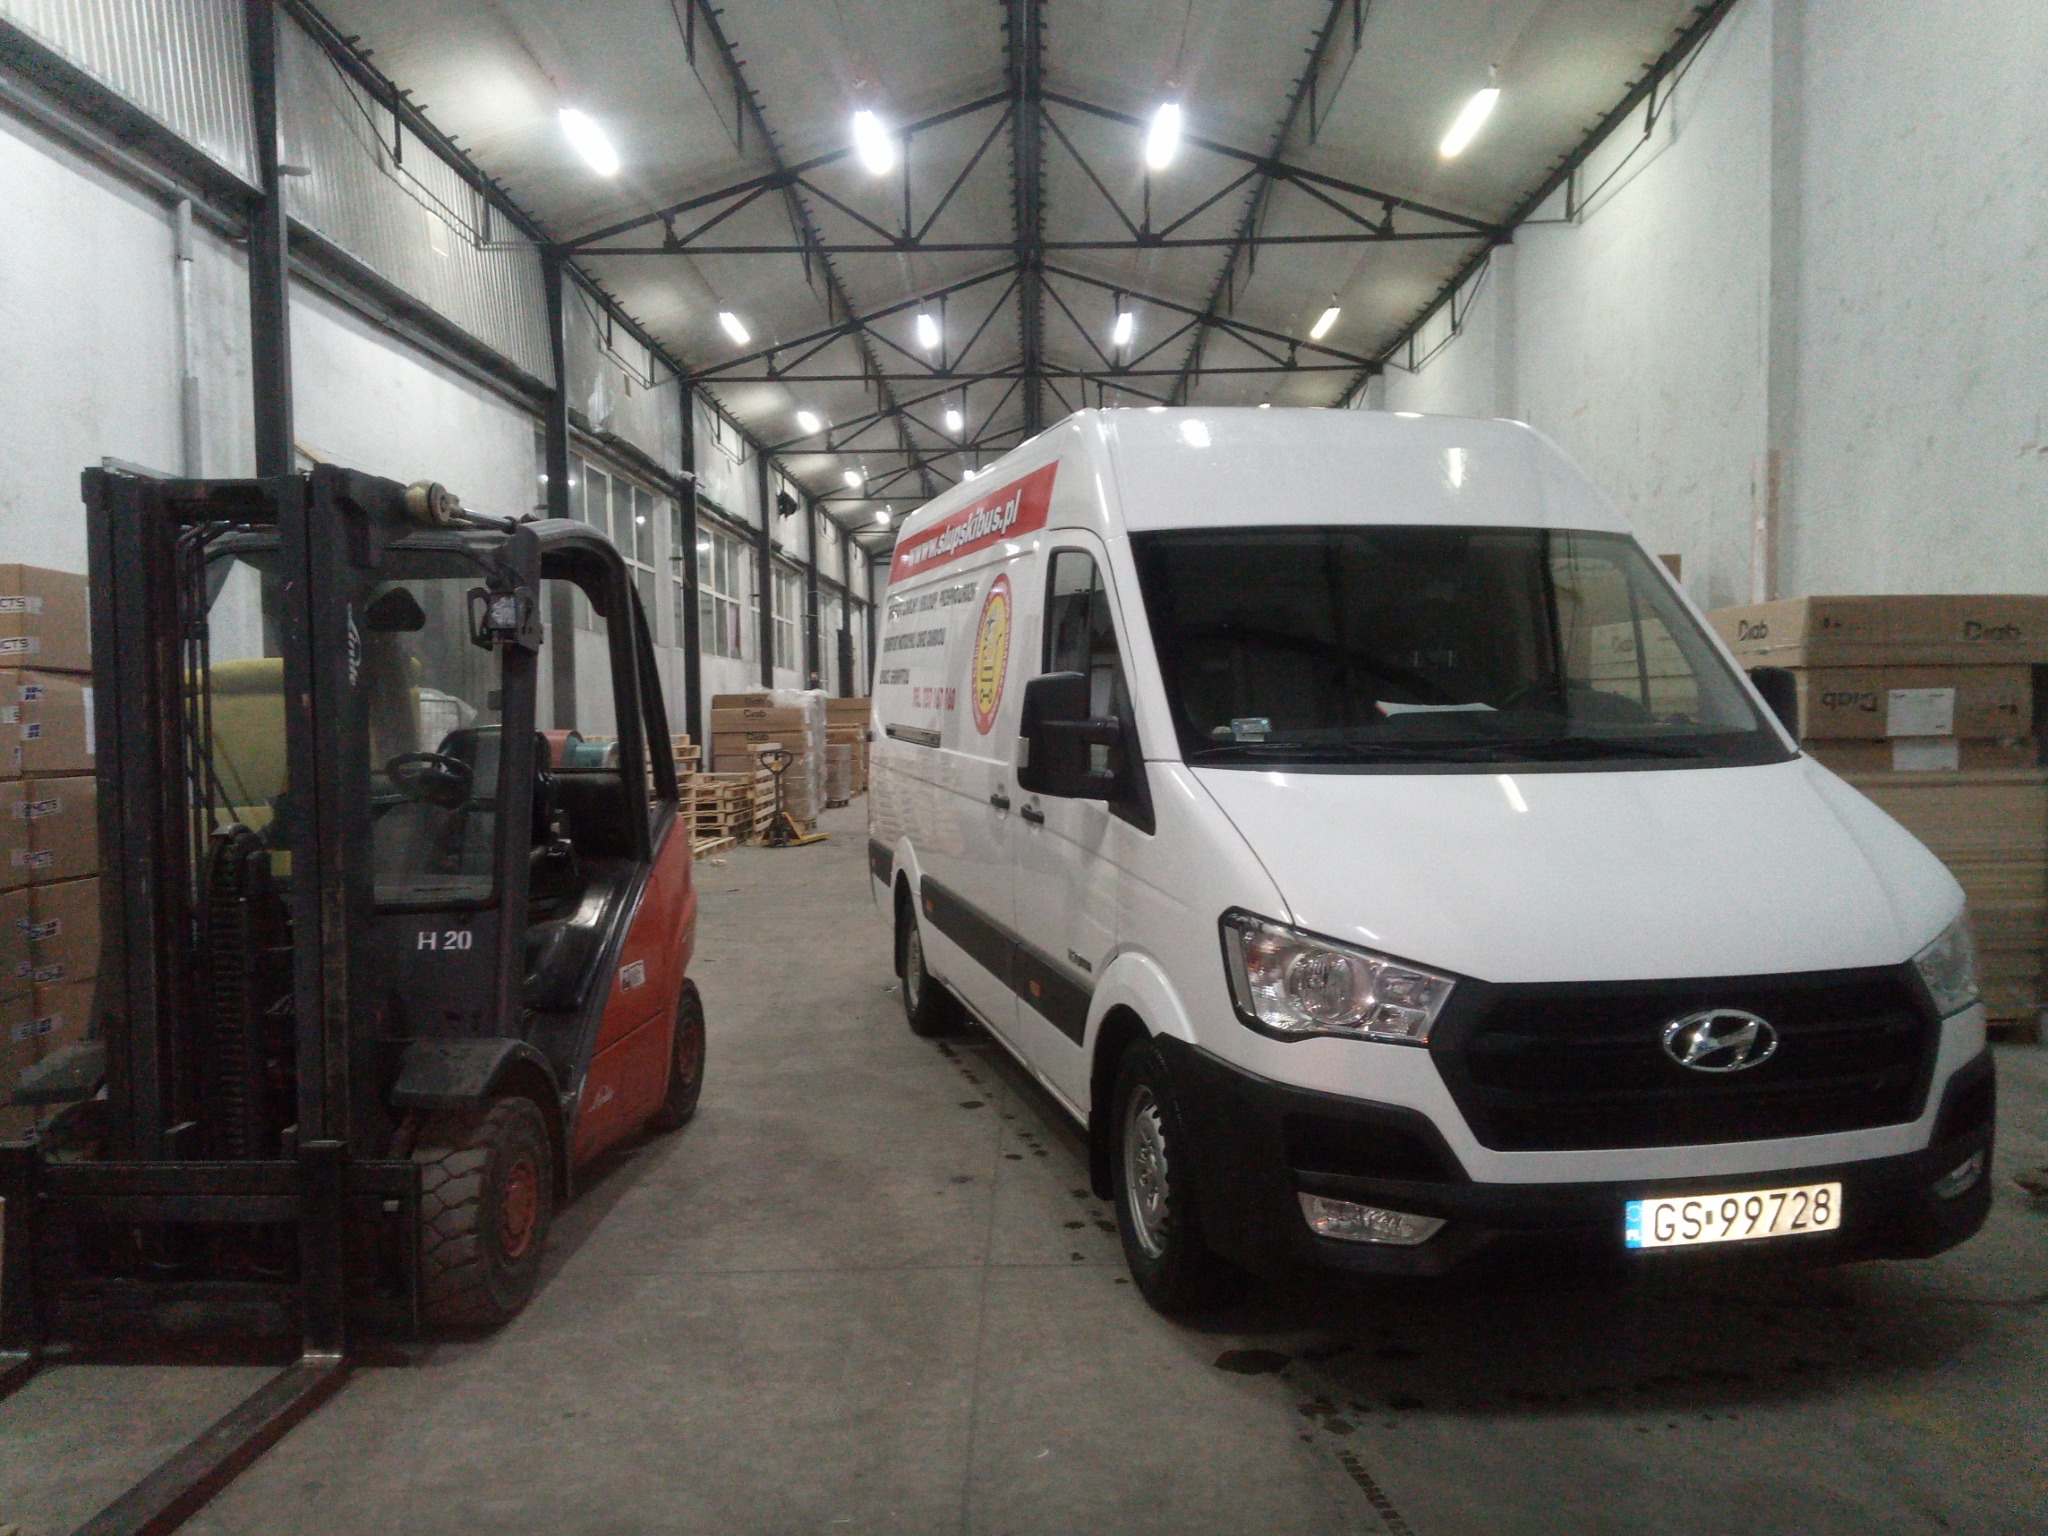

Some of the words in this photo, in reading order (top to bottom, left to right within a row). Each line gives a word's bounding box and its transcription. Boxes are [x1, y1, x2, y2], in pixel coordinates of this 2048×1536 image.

[417, 931, 437, 950] H
[442, 930, 473, 950] 20
[1654, 1201, 1702, 1242] GS
[1720, 1188, 1831, 1238] 99728
